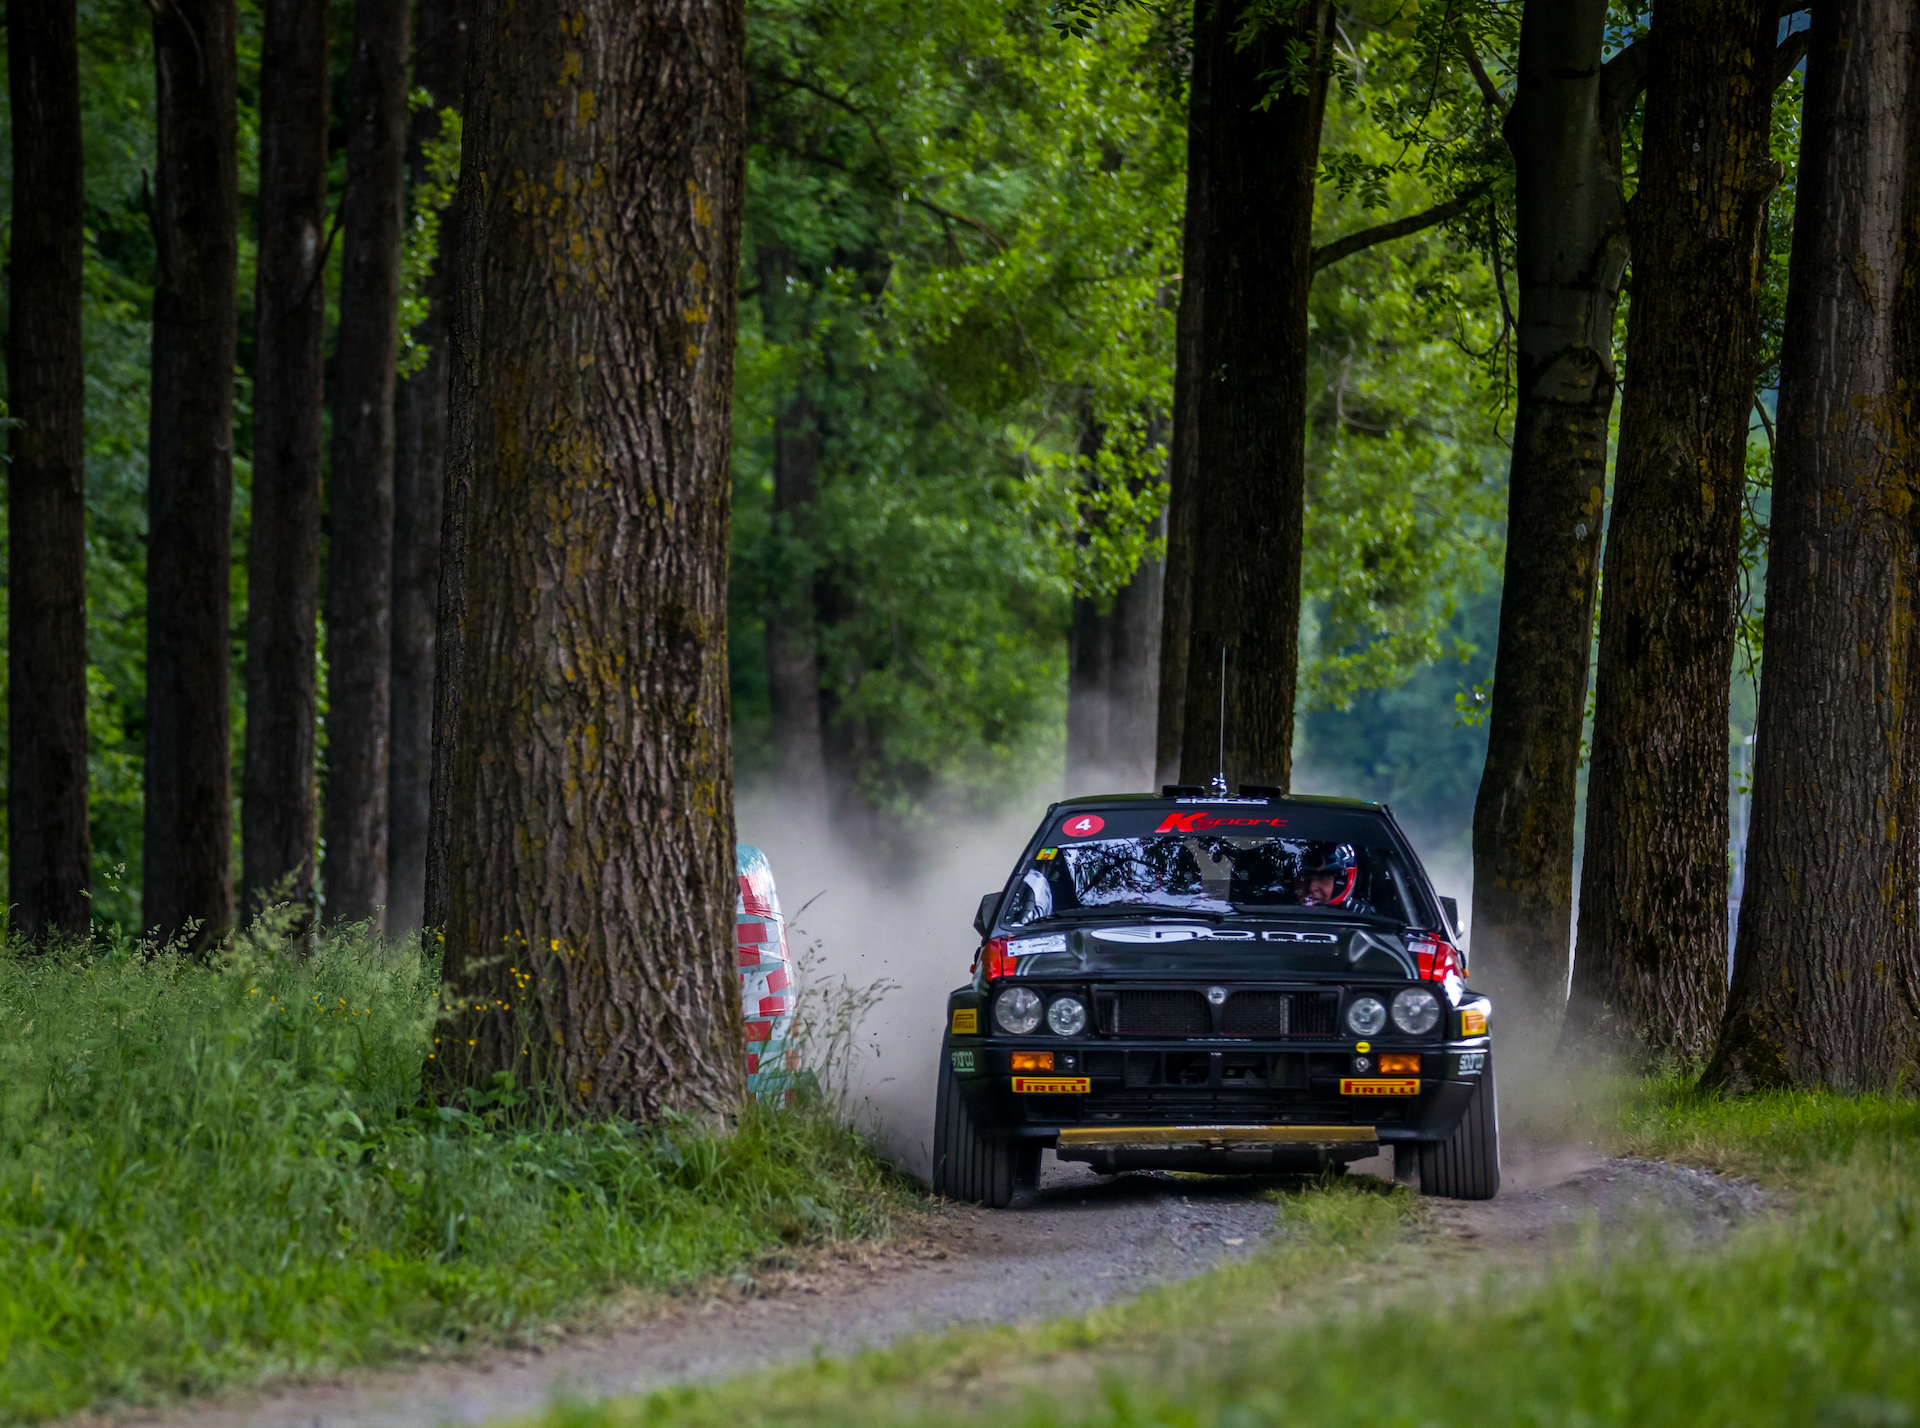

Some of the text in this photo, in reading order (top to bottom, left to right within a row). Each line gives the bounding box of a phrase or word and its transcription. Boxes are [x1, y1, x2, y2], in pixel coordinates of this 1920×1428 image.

[1075, 818, 1091, 831] 4
[1016, 1078, 1086, 1092] PIRELLI
[1344, 1080, 1416, 1093] PIRELLI
